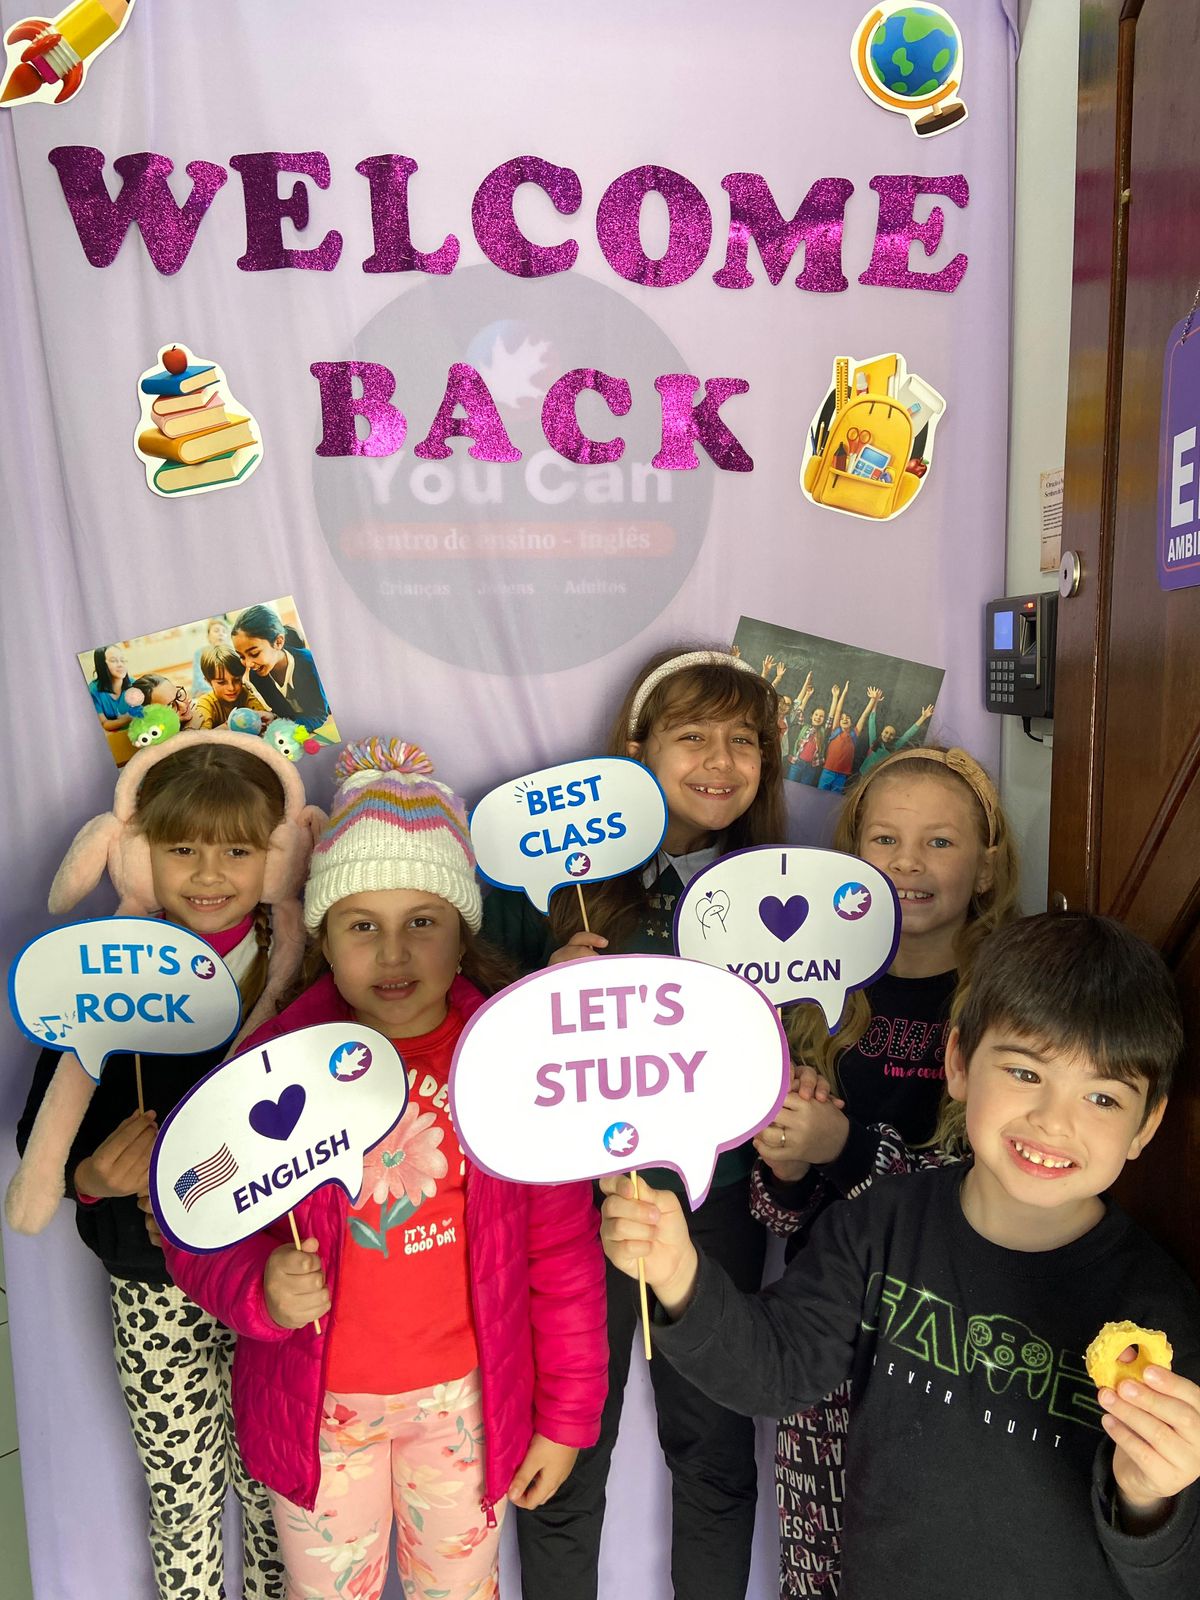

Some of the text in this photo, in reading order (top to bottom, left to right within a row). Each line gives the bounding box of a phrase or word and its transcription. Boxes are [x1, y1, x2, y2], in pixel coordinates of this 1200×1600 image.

[48, 145, 970, 293] WELCOME
[310, 360, 754, 473] BACK
[1171, 426, 1200, 528] E
[526, 775, 602, 816] BEST
[519, 812, 627, 858] CLASS
[781, 853, 787, 875] I
[79, 944, 181, 976] LET'S
[787, 959, 841, 983] CAN
[75, 992, 195, 1024] ROCK
[550, 982, 685, 1035] LET'S
[261, 1049, 272, 1074] I
[534, 1050, 708, 1107] STUDY
[232, 1129, 351, 1214] ENGLISH
[404, 1226, 457, 1255] GOOD DAY
[429, 1222, 438, 1236] A
[984, 1409, 1062, 1448] QUIT
